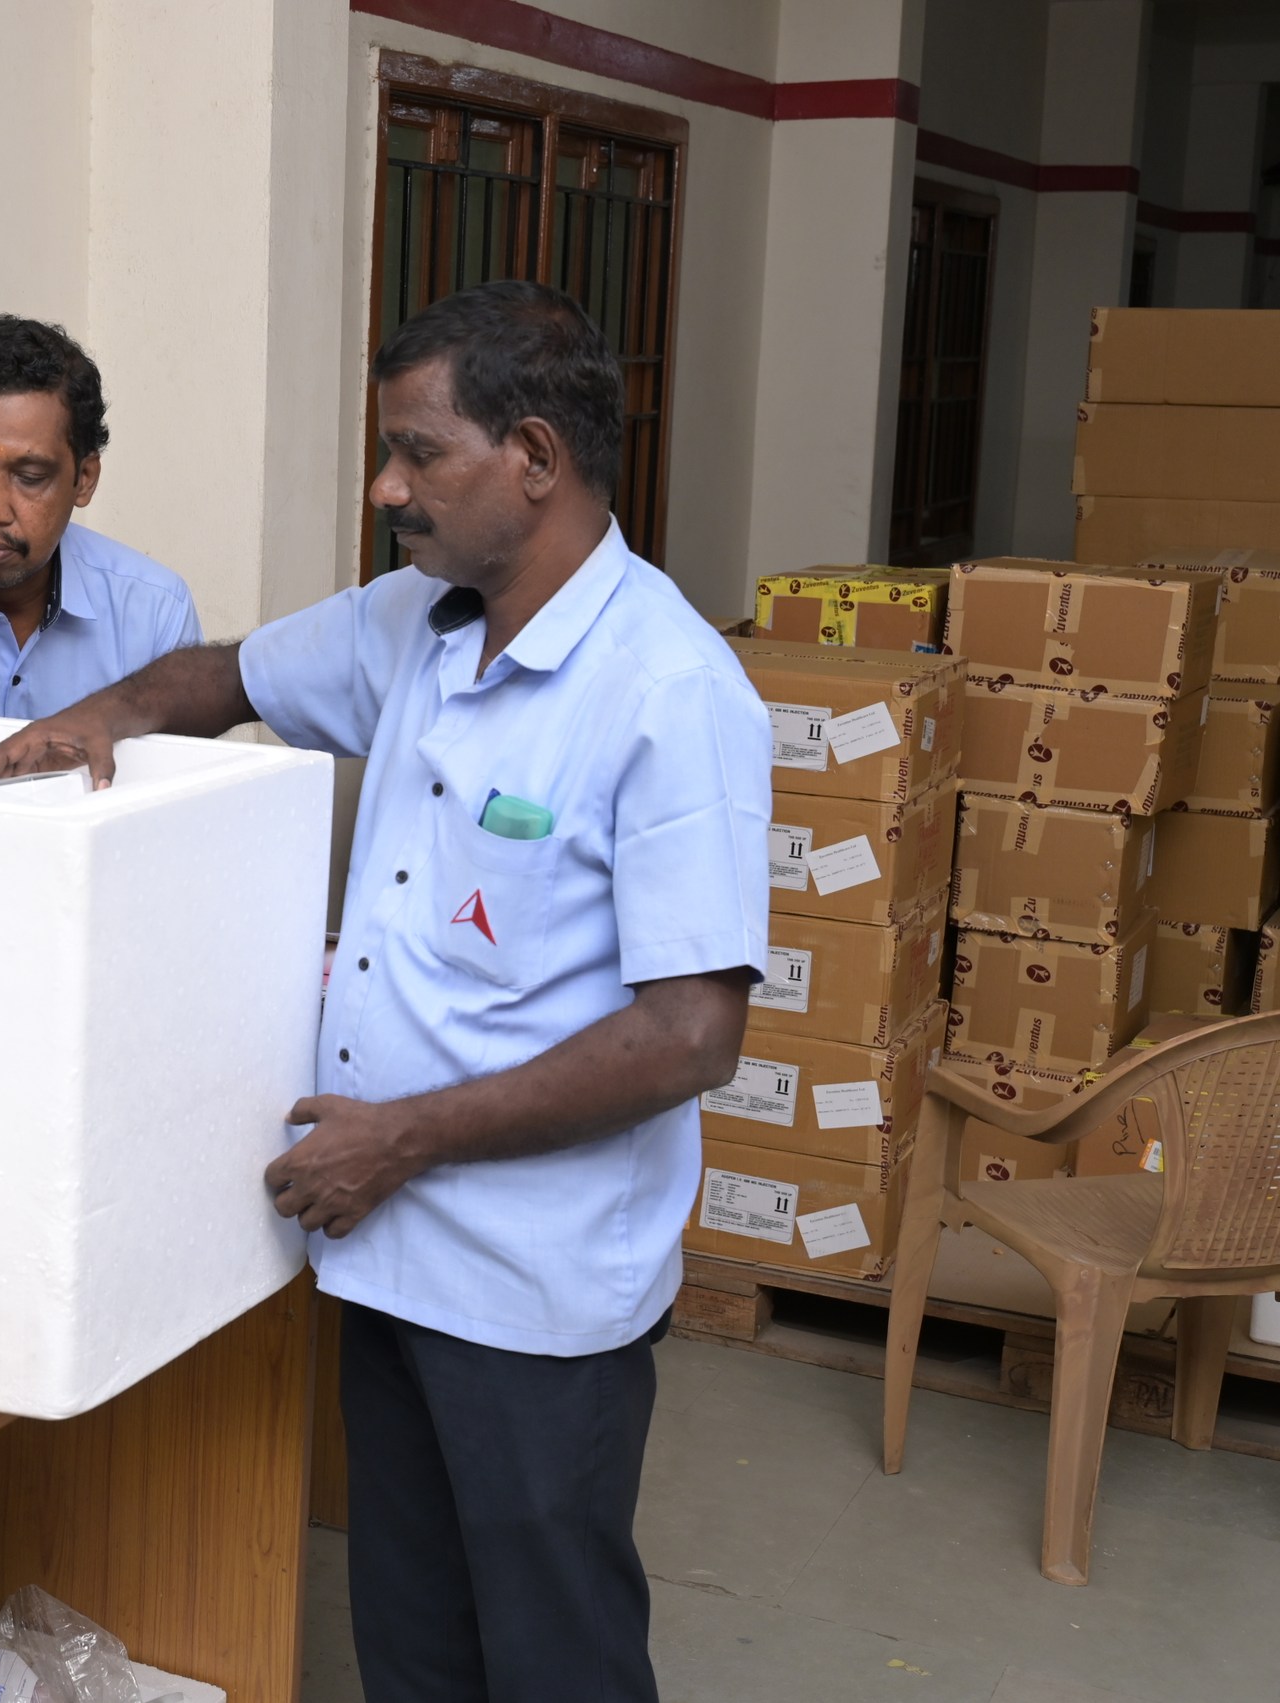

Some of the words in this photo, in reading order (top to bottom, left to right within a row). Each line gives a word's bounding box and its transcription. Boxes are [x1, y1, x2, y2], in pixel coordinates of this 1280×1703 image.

[802, 580, 829, 590] Zuventus
[851, 583, 880, 594] Zuventus
[902, 587, 927, 597] Zuven
[873, 1004, 889, 1047] Zuven
